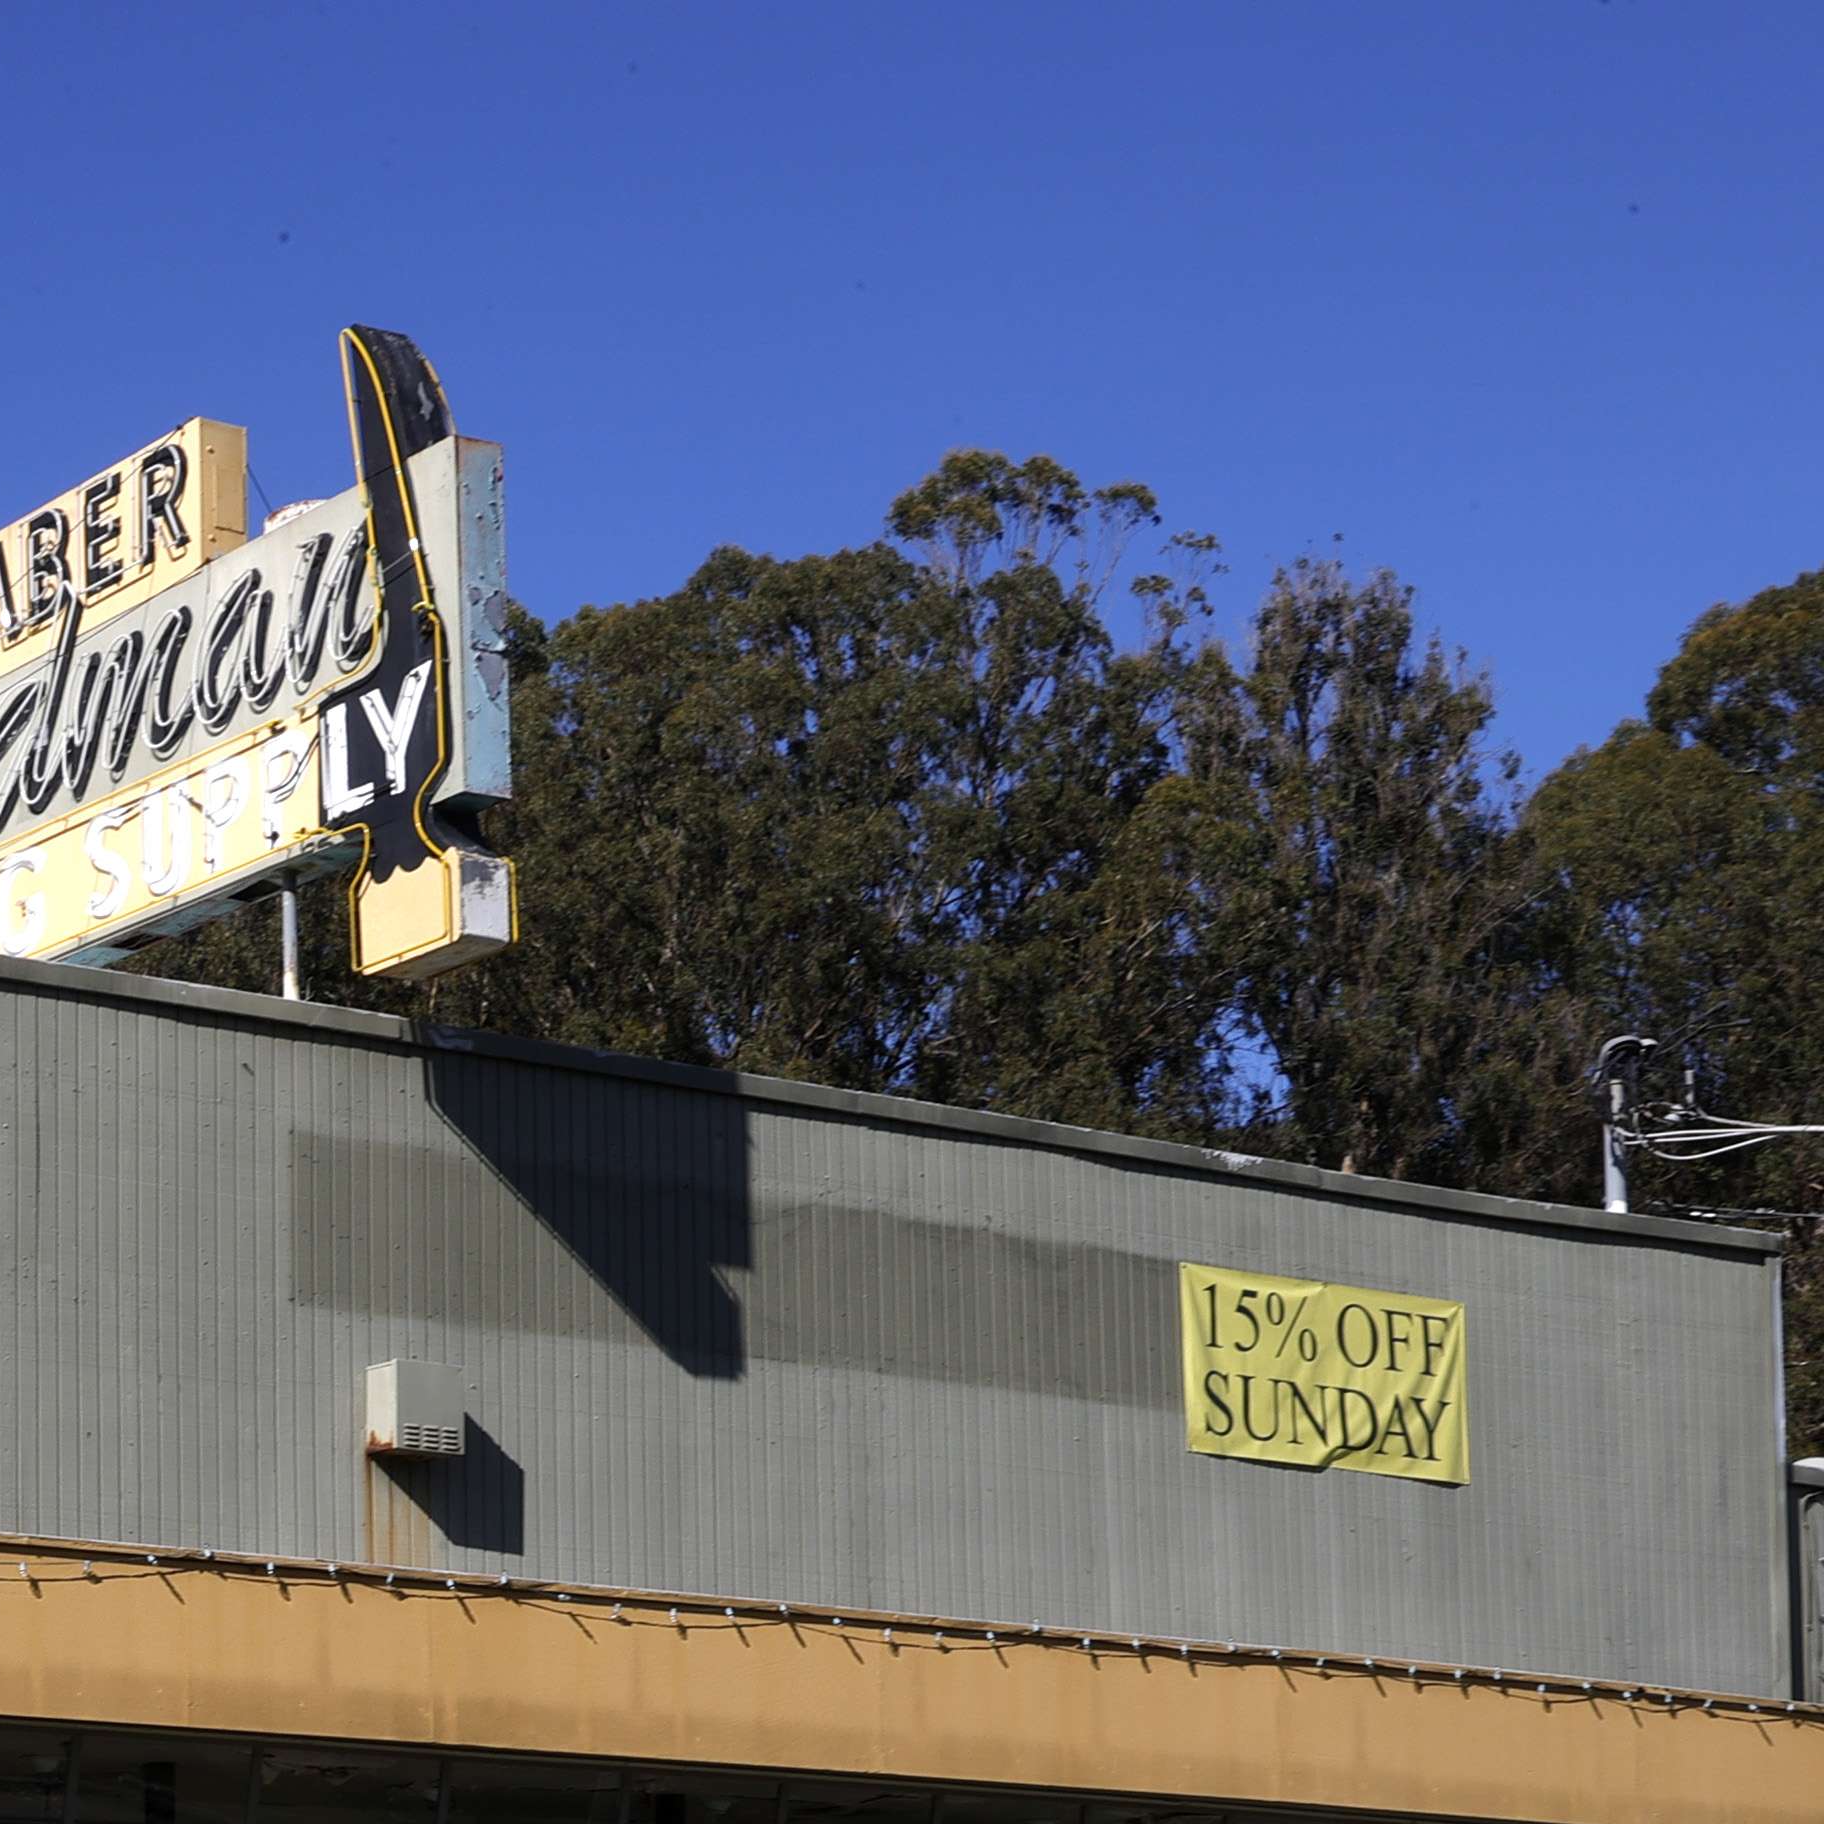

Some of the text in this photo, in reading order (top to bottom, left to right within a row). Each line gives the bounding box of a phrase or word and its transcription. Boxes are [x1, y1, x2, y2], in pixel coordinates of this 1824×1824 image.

[85, 660, 433, 920] SUPPLY
[1203, 1284, 1448, 1377] 15% OFF
[1204, 1370, 1451, 1461] SUNDAY
